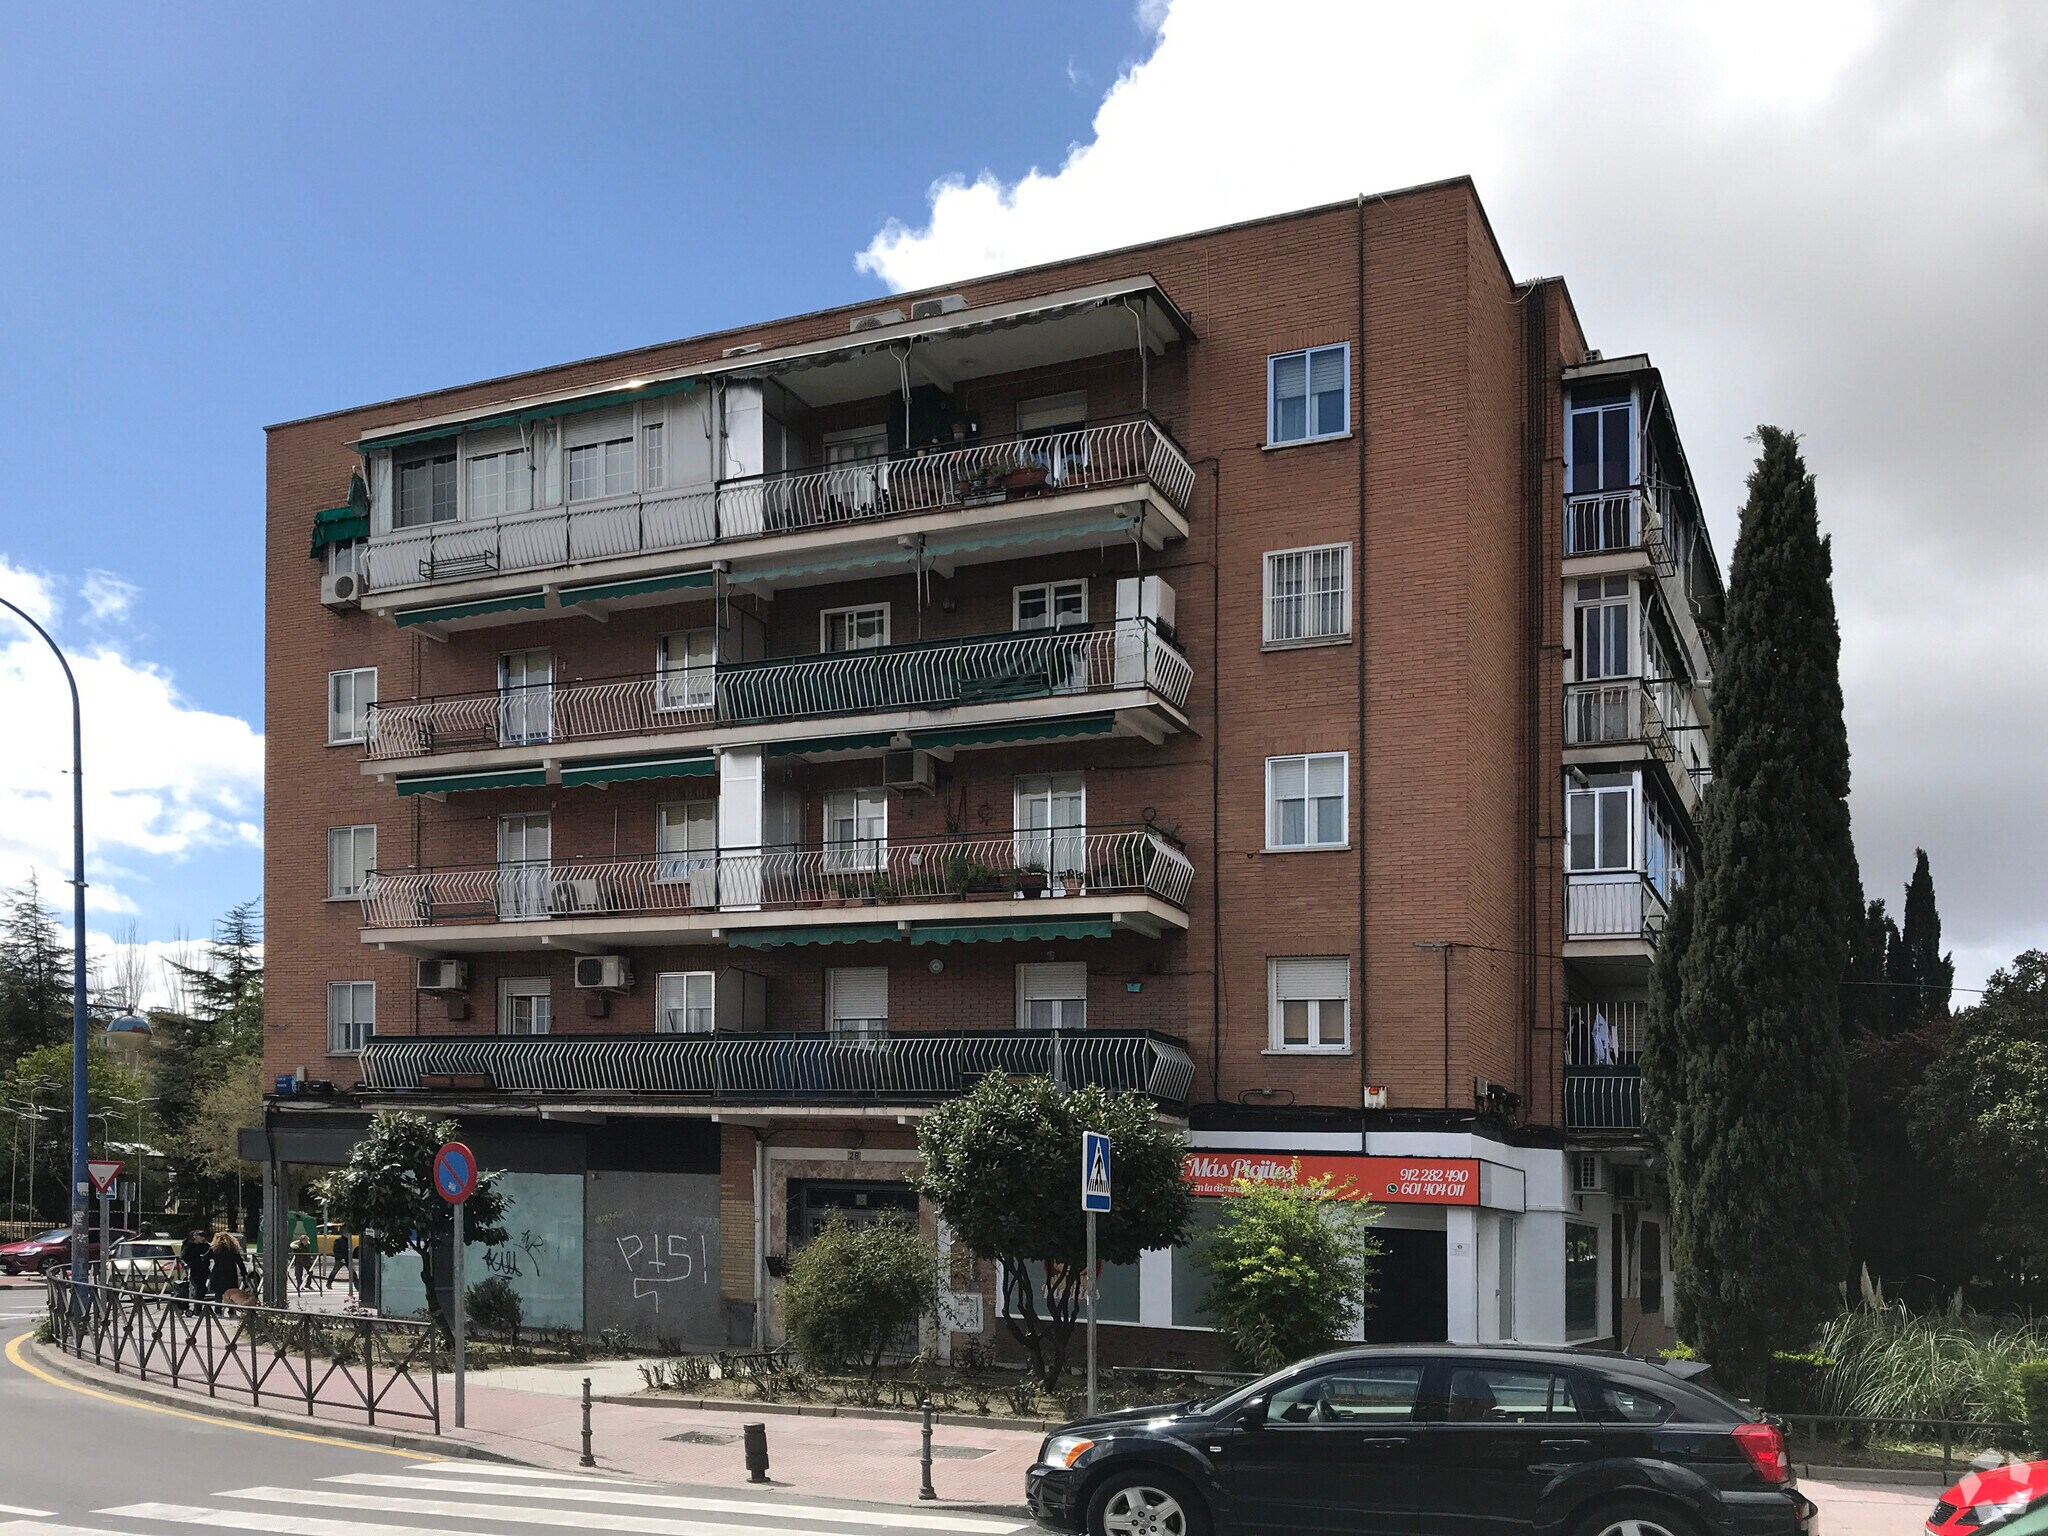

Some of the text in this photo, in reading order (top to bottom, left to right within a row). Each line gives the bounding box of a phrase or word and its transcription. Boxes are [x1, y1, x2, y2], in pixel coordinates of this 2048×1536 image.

[848, 1152, 859, 1160] 28
[1189, 1157, 1229, 1177] Más
[1400, 1168, 1469, 1182] 912 282 490
[1204, 1183, 1212, 1192] la
[1401, 1182, 1465, 1196] 601 404 011
